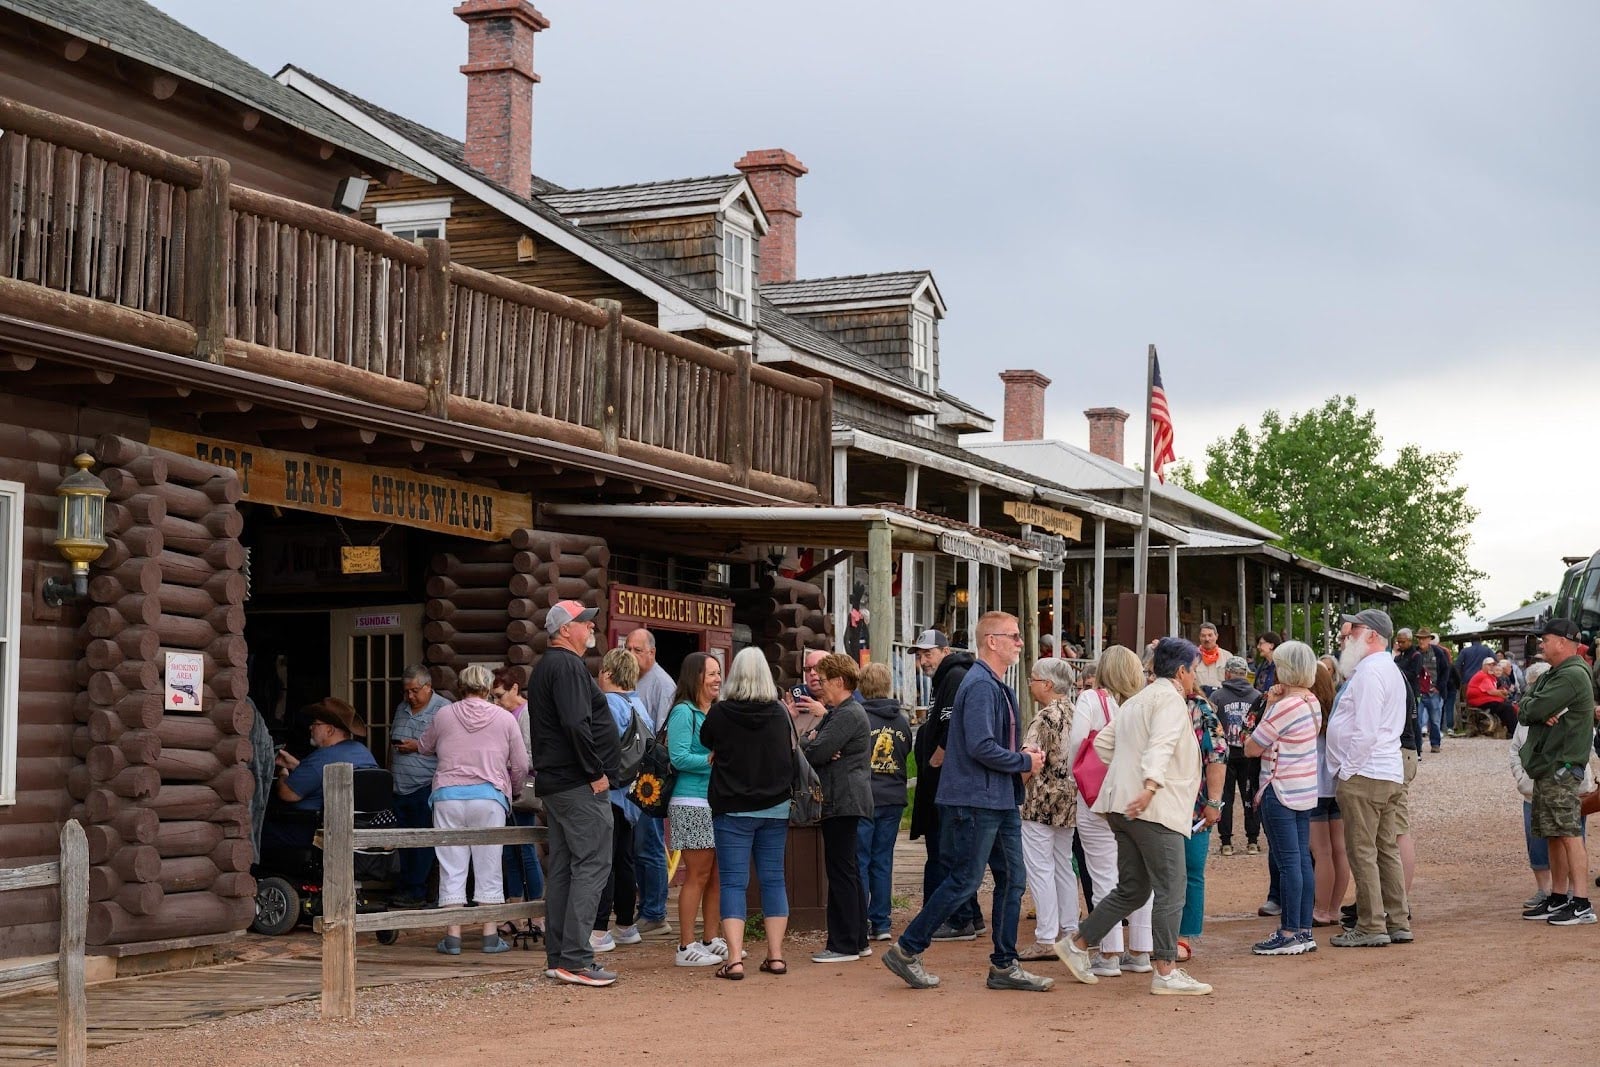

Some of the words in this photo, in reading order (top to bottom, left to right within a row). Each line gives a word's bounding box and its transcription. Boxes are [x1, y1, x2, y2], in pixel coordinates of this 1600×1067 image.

[285, 459, 342, 508] HAYS
[371, 474, 493, 532] CHUCKWAGON
[618, 590, 692, 622] STAGECOACH
[697, 601, 726, 627] WEST
[359, 616, 391, 626] SUNDAE
[171, 664, 198, 672] SMOKING
[176, 672, 193, 680] AREA
[1224, 701, 1240, 713] IRON
